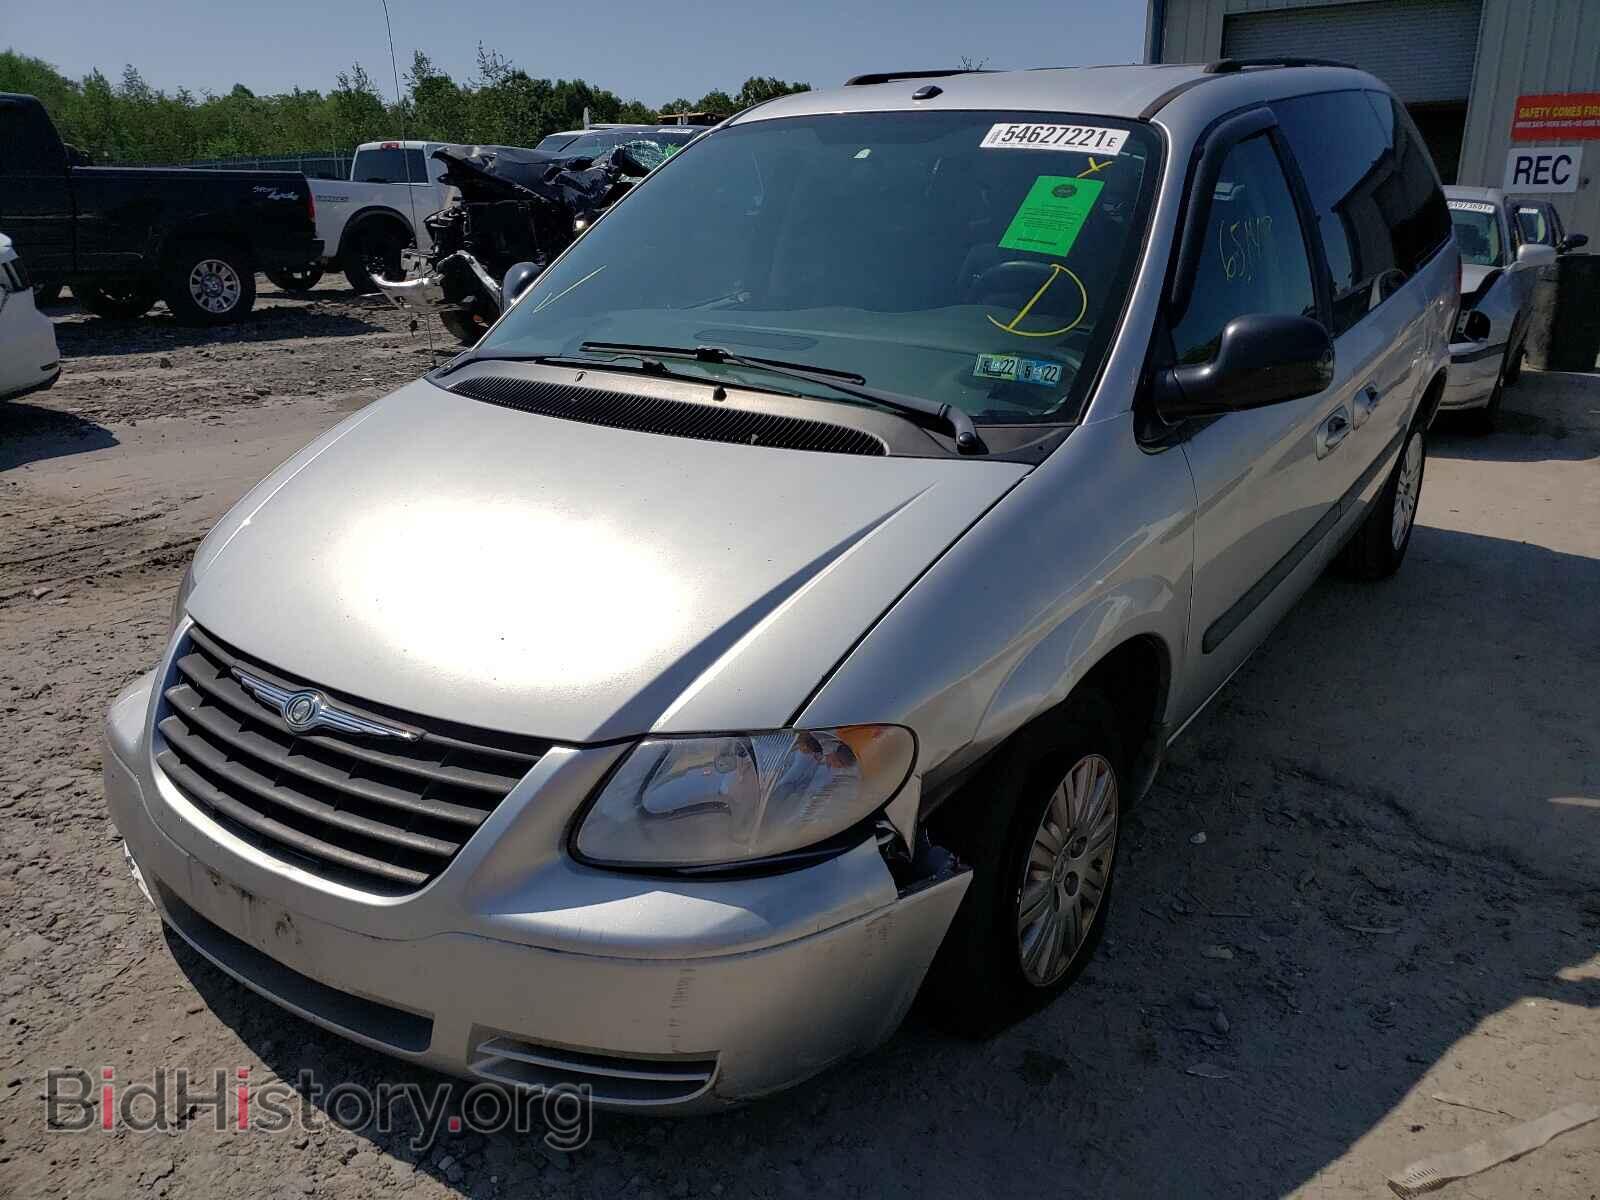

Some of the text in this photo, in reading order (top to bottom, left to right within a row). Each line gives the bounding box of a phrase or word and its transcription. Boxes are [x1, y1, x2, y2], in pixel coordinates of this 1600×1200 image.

[1519, 107, 1551, 119] SAFETY
[1552, 106, 1582, 117] COMES
[1002, 125, 1107, 148] 54627221
[1513, 154, 1572, 185] REC
[1001, 359, 1016, 375] 22
[1043, 365, 1058, 382] 22
